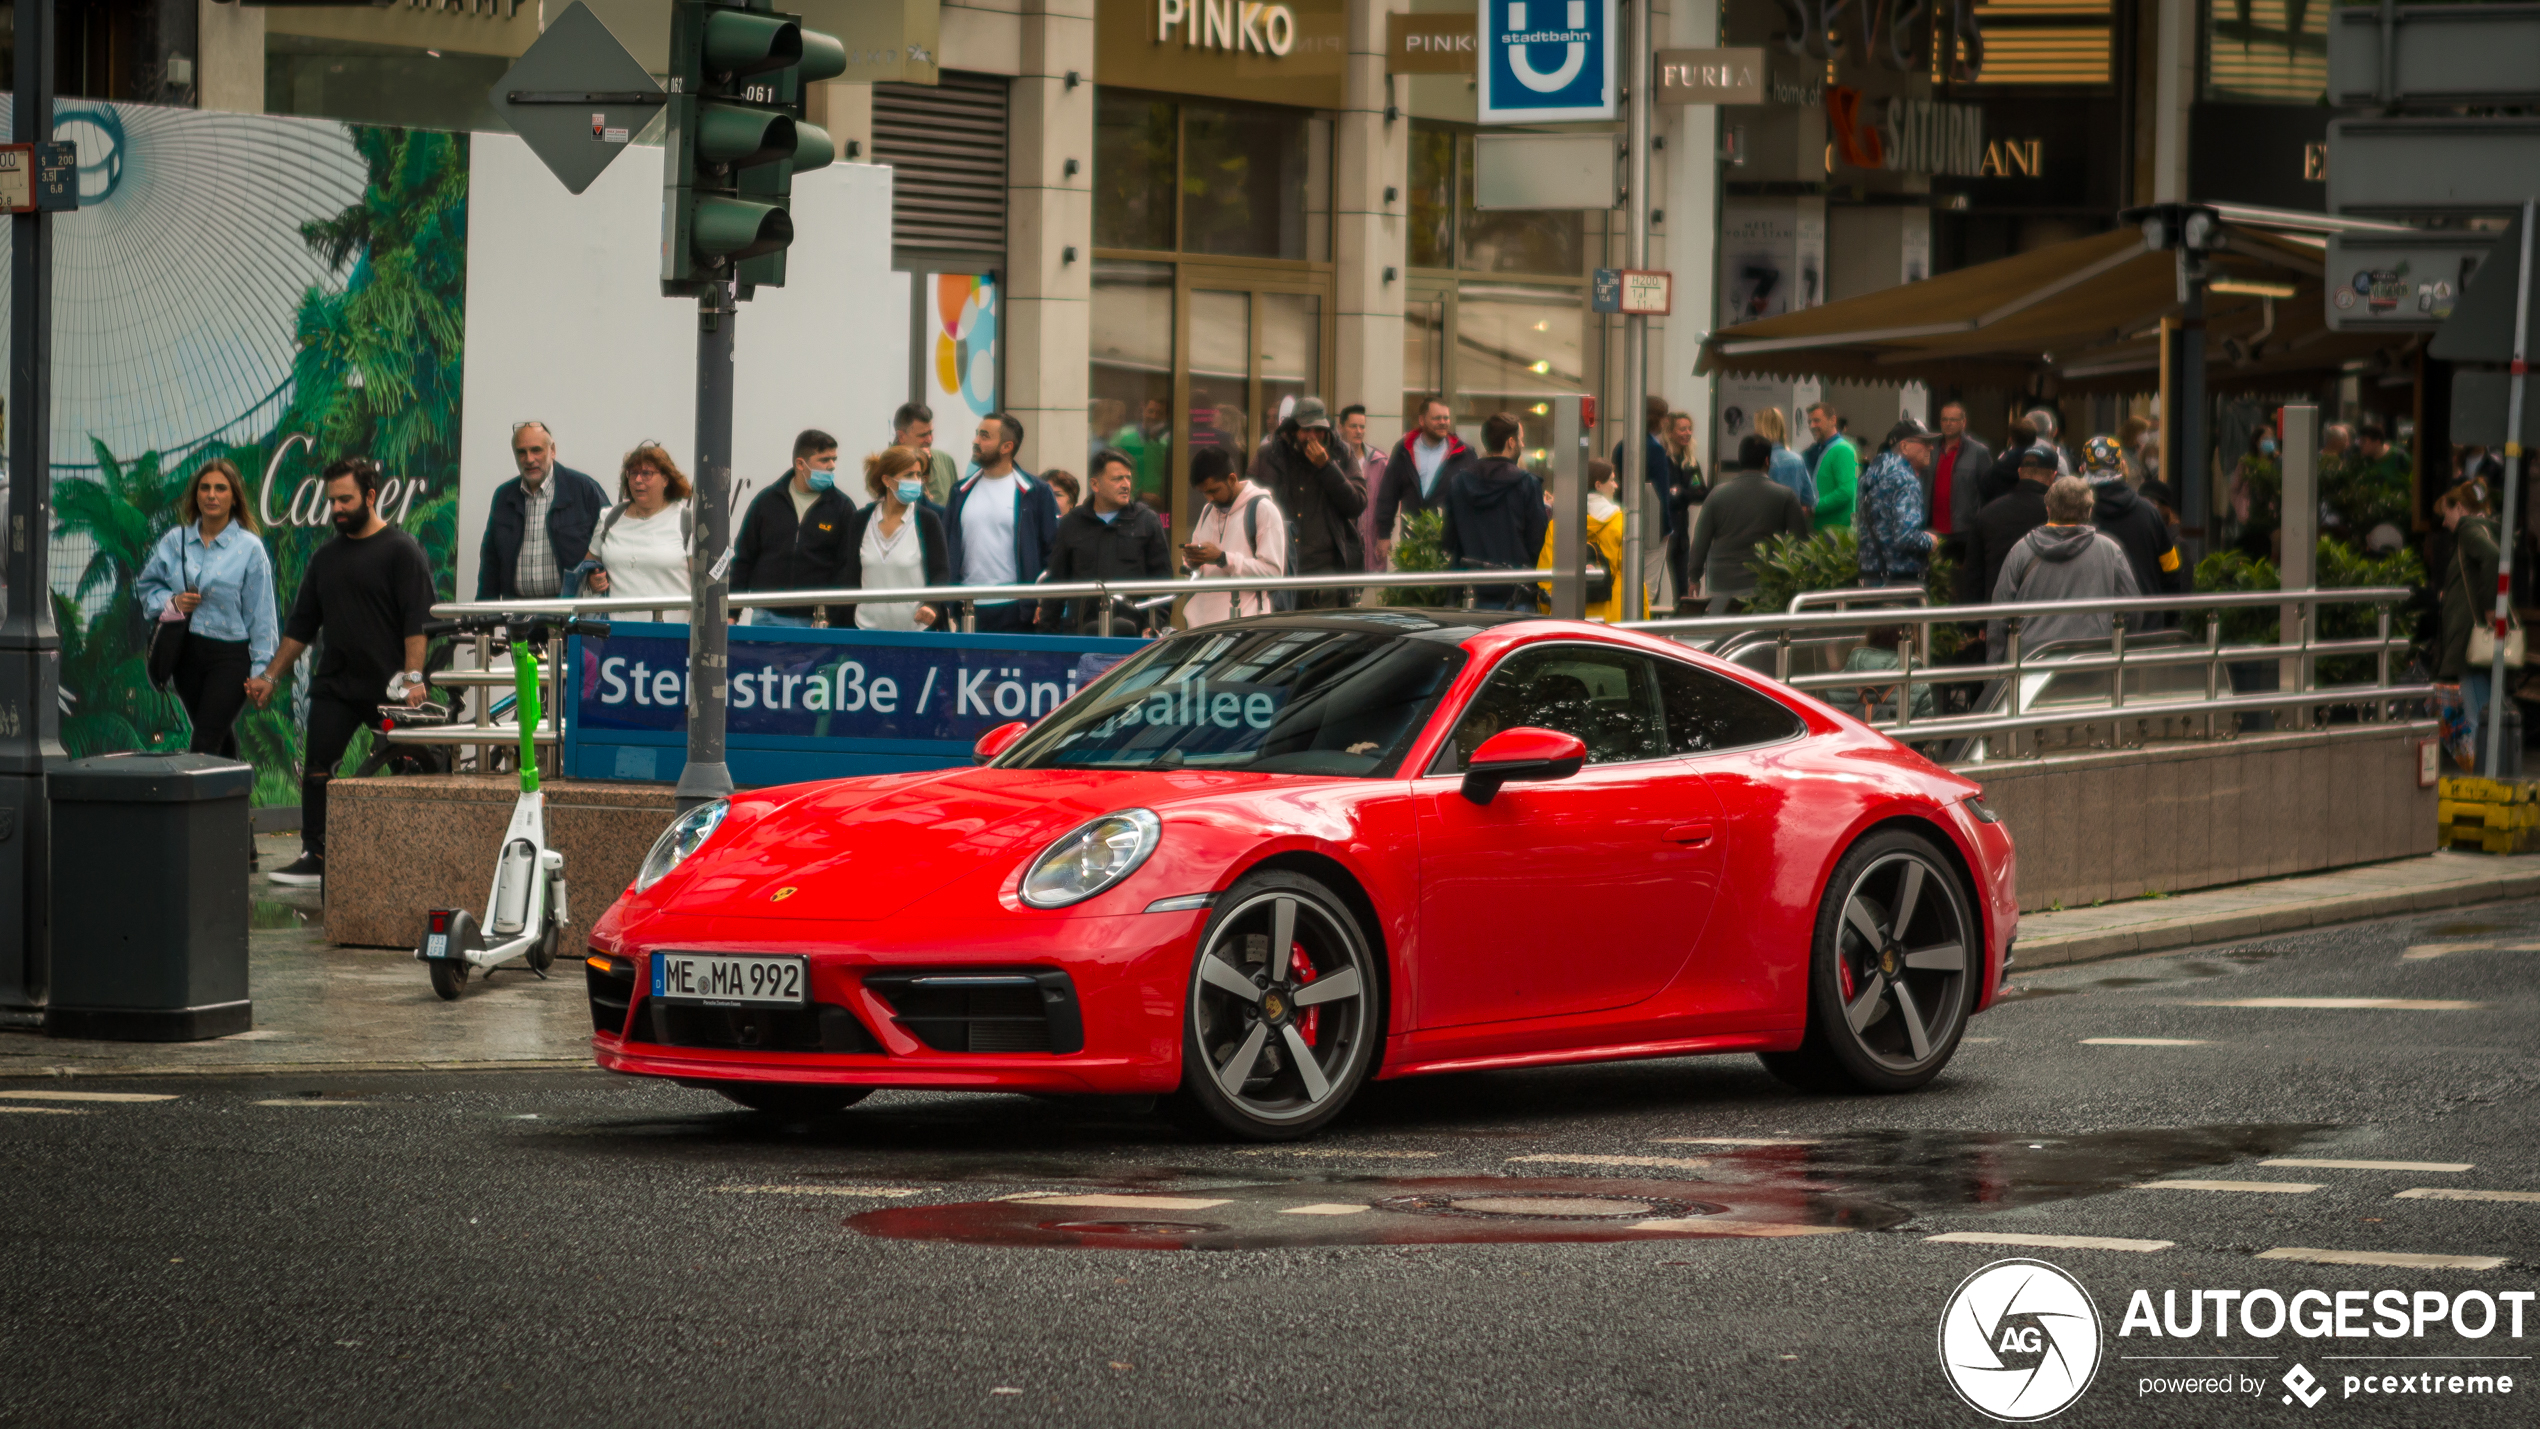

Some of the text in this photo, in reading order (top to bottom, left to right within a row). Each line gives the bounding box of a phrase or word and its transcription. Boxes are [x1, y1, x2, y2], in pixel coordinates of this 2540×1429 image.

[1158, 0, 1293, 56] PINKO
[1501, 30, 1591, 43] stadtbahn
[1405, 35, 1477, 52] PINK
[670, 77, 683, 93] 062
[1773, 70, 1806, 104] home
[746, 86, 772, 103] 061
[1886, 95, 1982, 177] SATURN
[58, 155, 74, 166] 200
[260, 433, 427, 526] Caer
[600, 656, 899, 714] Stestraße
[915, 666, 938, 715] /
[430, 935, 444, 945] 731
[655, 979, 661, 989] D
[665, 959, 800, 998] ME MA 992
